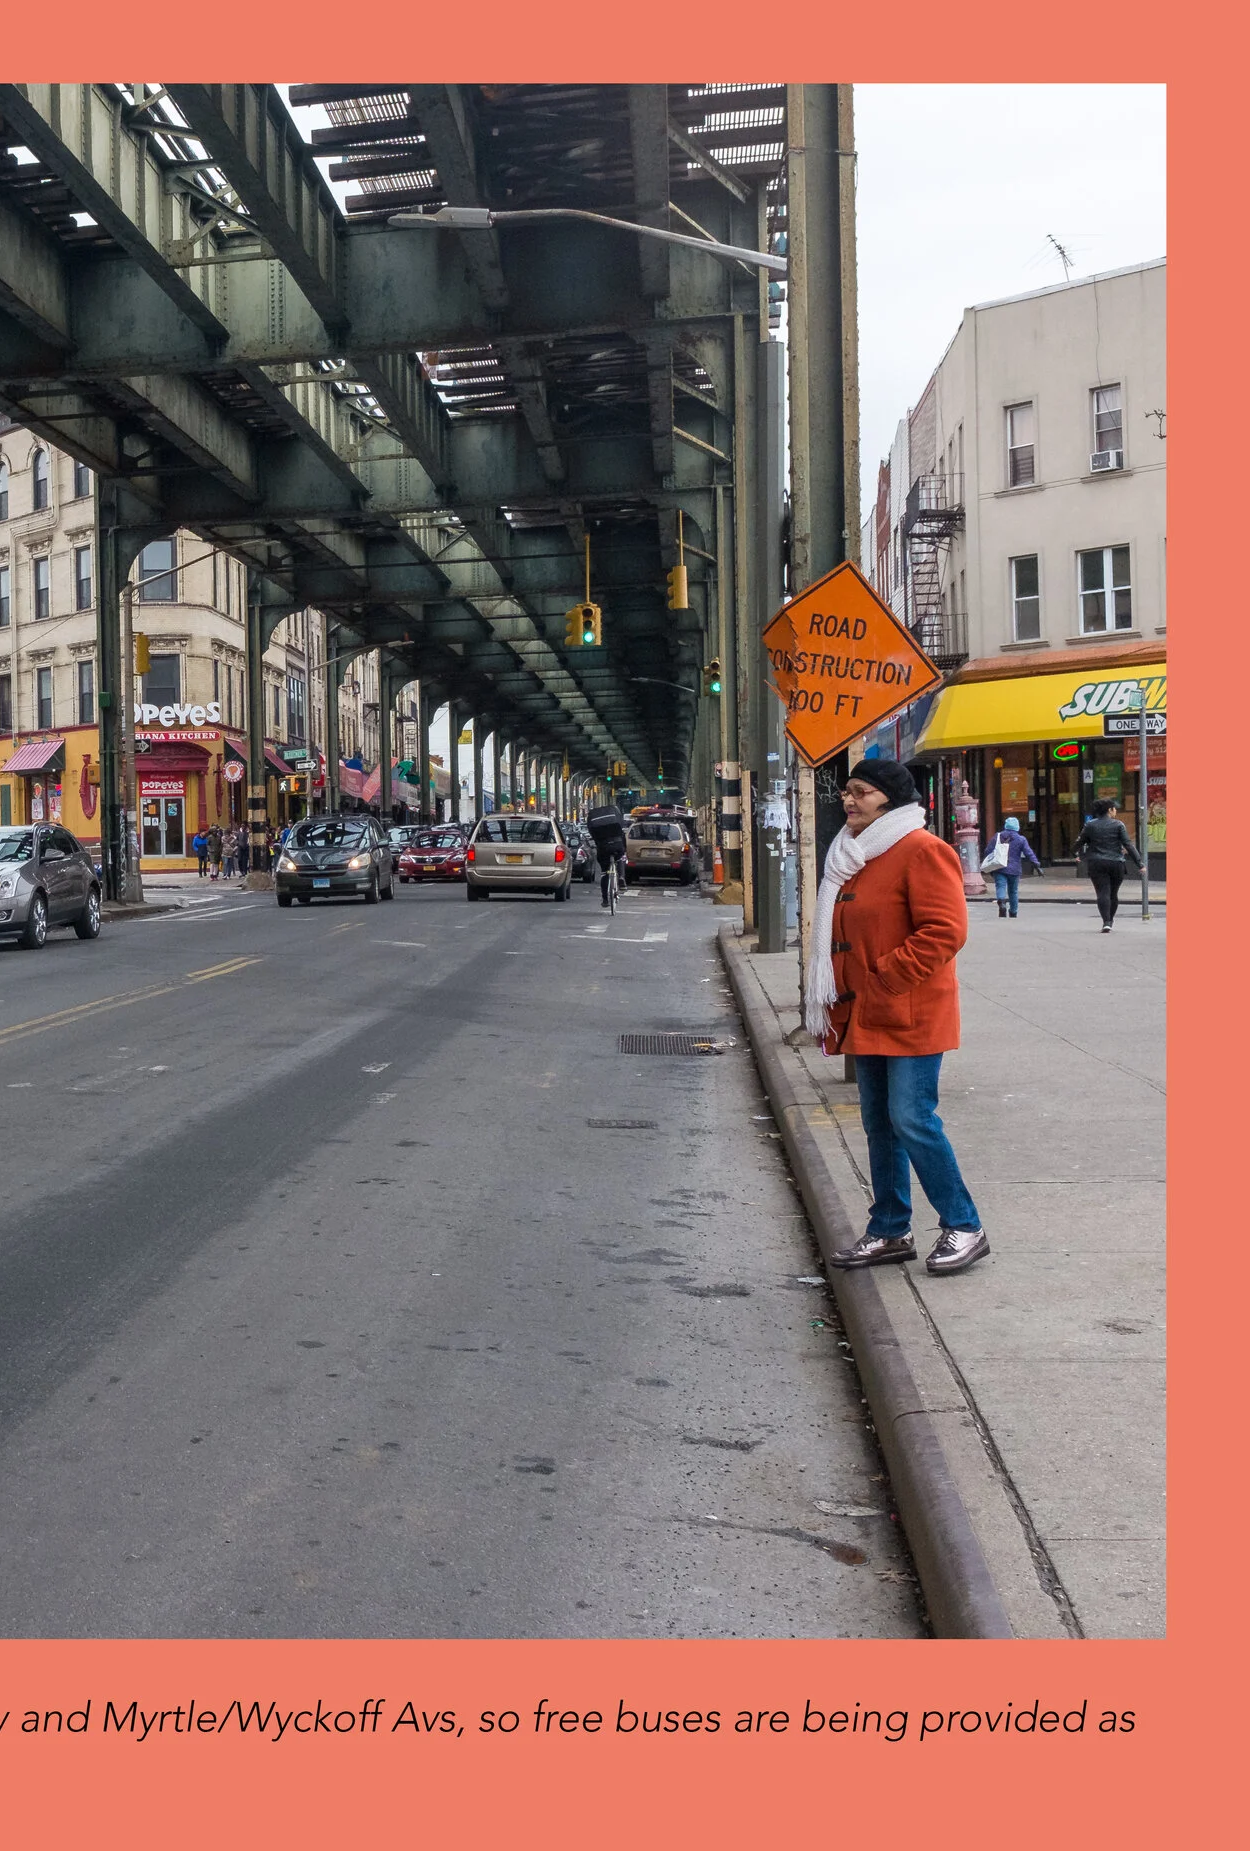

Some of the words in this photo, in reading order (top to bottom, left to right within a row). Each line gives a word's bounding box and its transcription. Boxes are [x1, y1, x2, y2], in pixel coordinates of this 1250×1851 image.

[809, 613, 867, 641] ROAD
[767, 648, 913, 686] ONSTRUCTION
[835, 694, 863, 718] FT
[168, 732, 216, 740] KITCHEN
[1116, 721, 1137, 730] ONE
[1146, 719, 1165, 728] WAY
